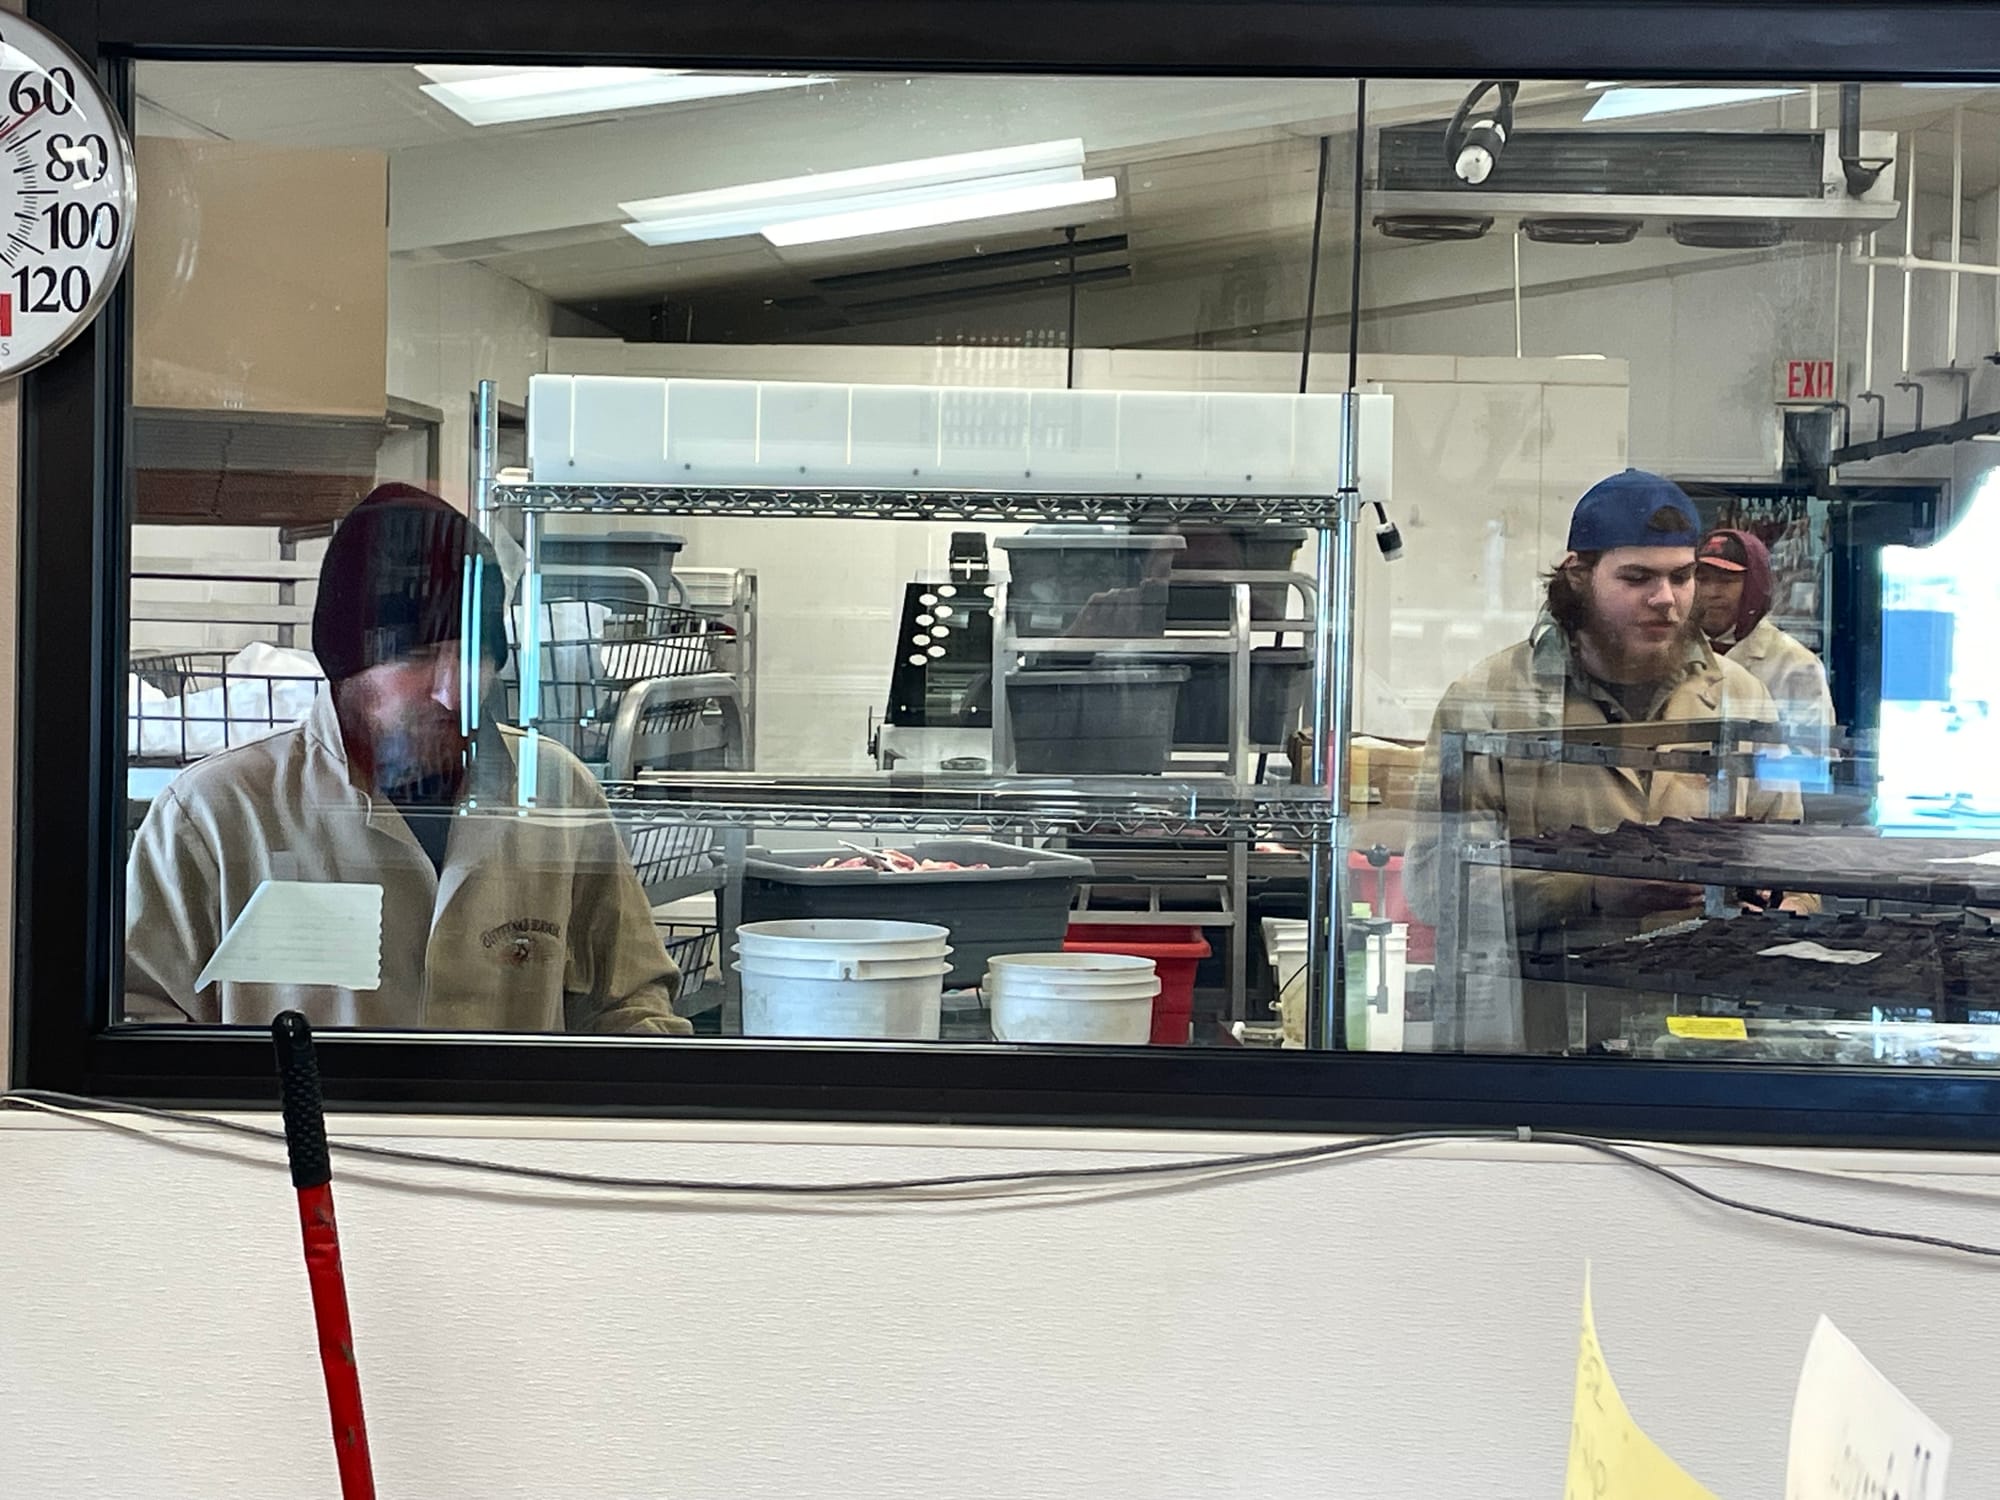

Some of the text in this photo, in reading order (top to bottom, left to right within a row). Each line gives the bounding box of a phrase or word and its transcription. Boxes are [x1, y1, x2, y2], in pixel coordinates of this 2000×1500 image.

[9, 67, 75, 116] 60
[46, 134, 108, 182] 80
[42, 202, 120, 250] 100
[11, 265, 91, 313] 120
[1788, 361, 1834, 398] EXIT
